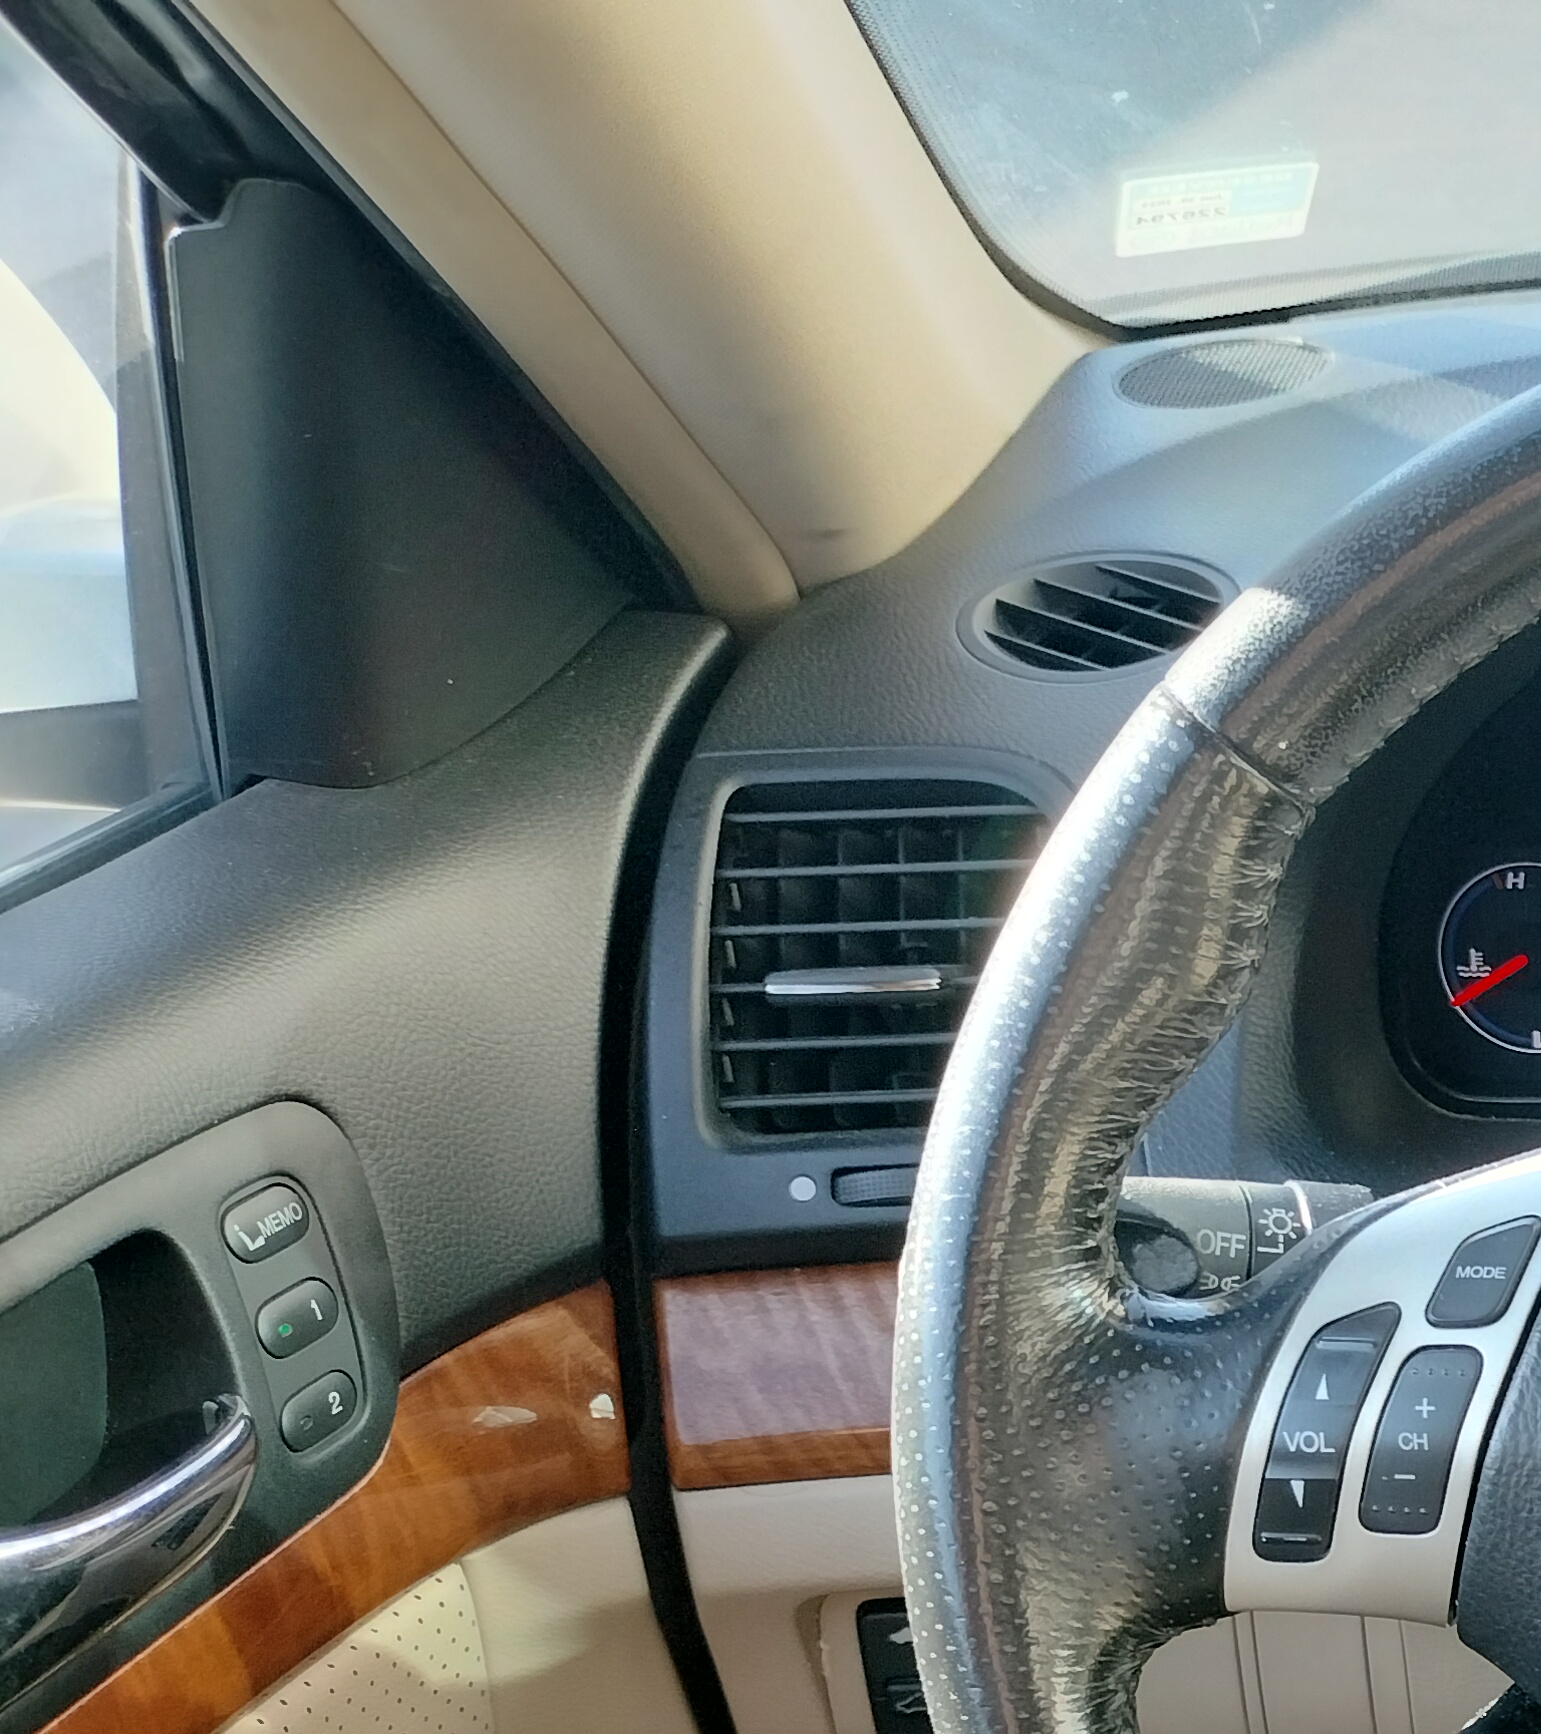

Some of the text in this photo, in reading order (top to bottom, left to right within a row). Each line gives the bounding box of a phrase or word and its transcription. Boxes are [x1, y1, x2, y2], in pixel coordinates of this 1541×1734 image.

[1506, 872, 1525, 889] H
[258, 1202, 302, 1237] MEMO
[1197, 1229, 1247, 1258] OFF
[1455, 1265, 1507, 1280] MODE
[311, 1300, 322, 1320] 1
[328, 1392, 342, 1414] 2
[1283, 1432, 1336, 1453] VOL
[1398, 1432, 1429, 1451] CH
